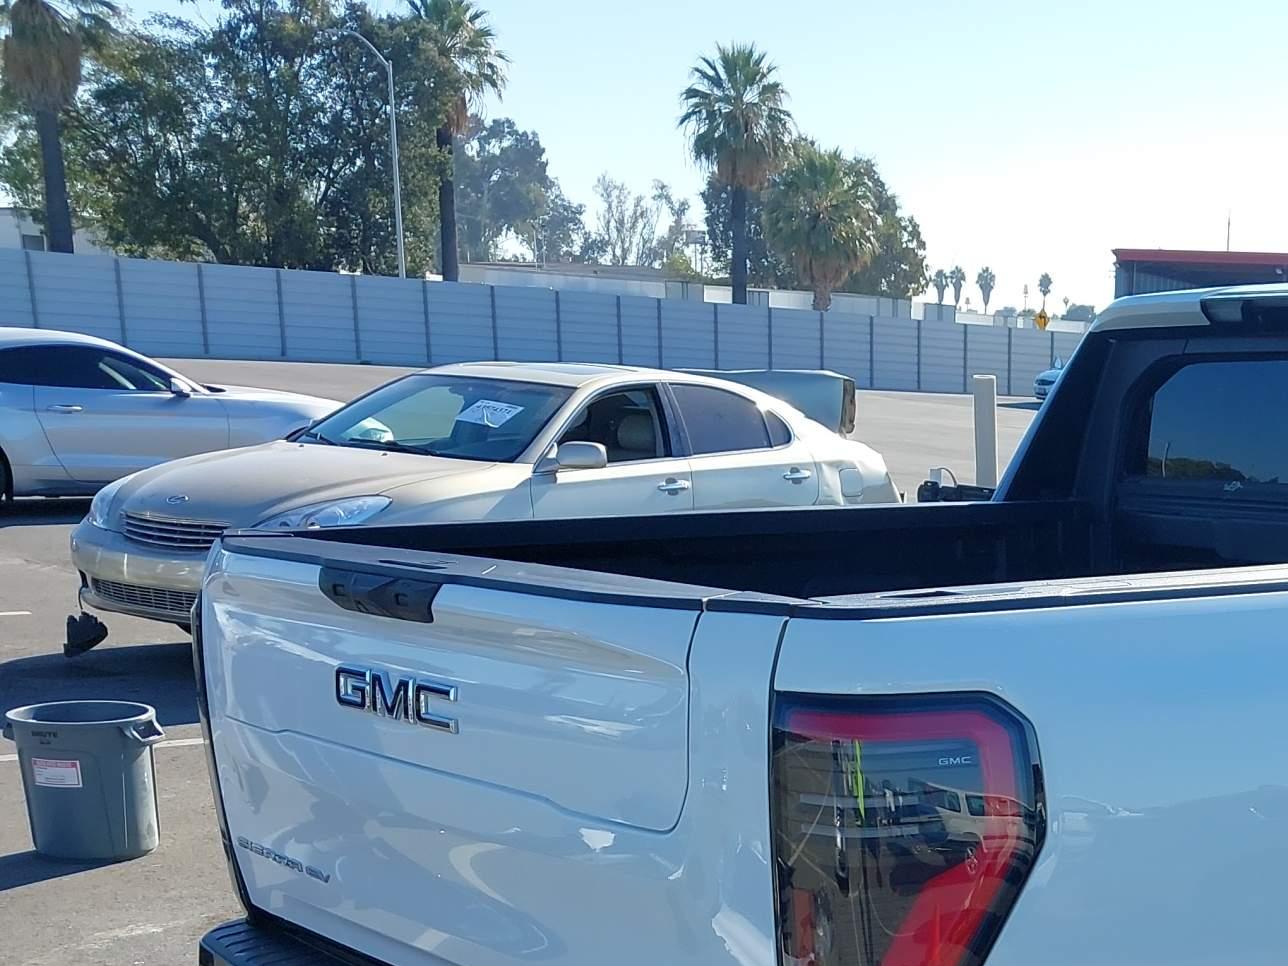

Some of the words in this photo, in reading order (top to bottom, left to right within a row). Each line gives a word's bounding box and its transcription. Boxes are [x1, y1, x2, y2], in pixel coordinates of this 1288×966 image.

[335, 666, 460, 735] GMC
[938, 756, 972, 766] GMC
[237, 836, 303, 873] SIERRA
[306, 865, 331, 883] EV
